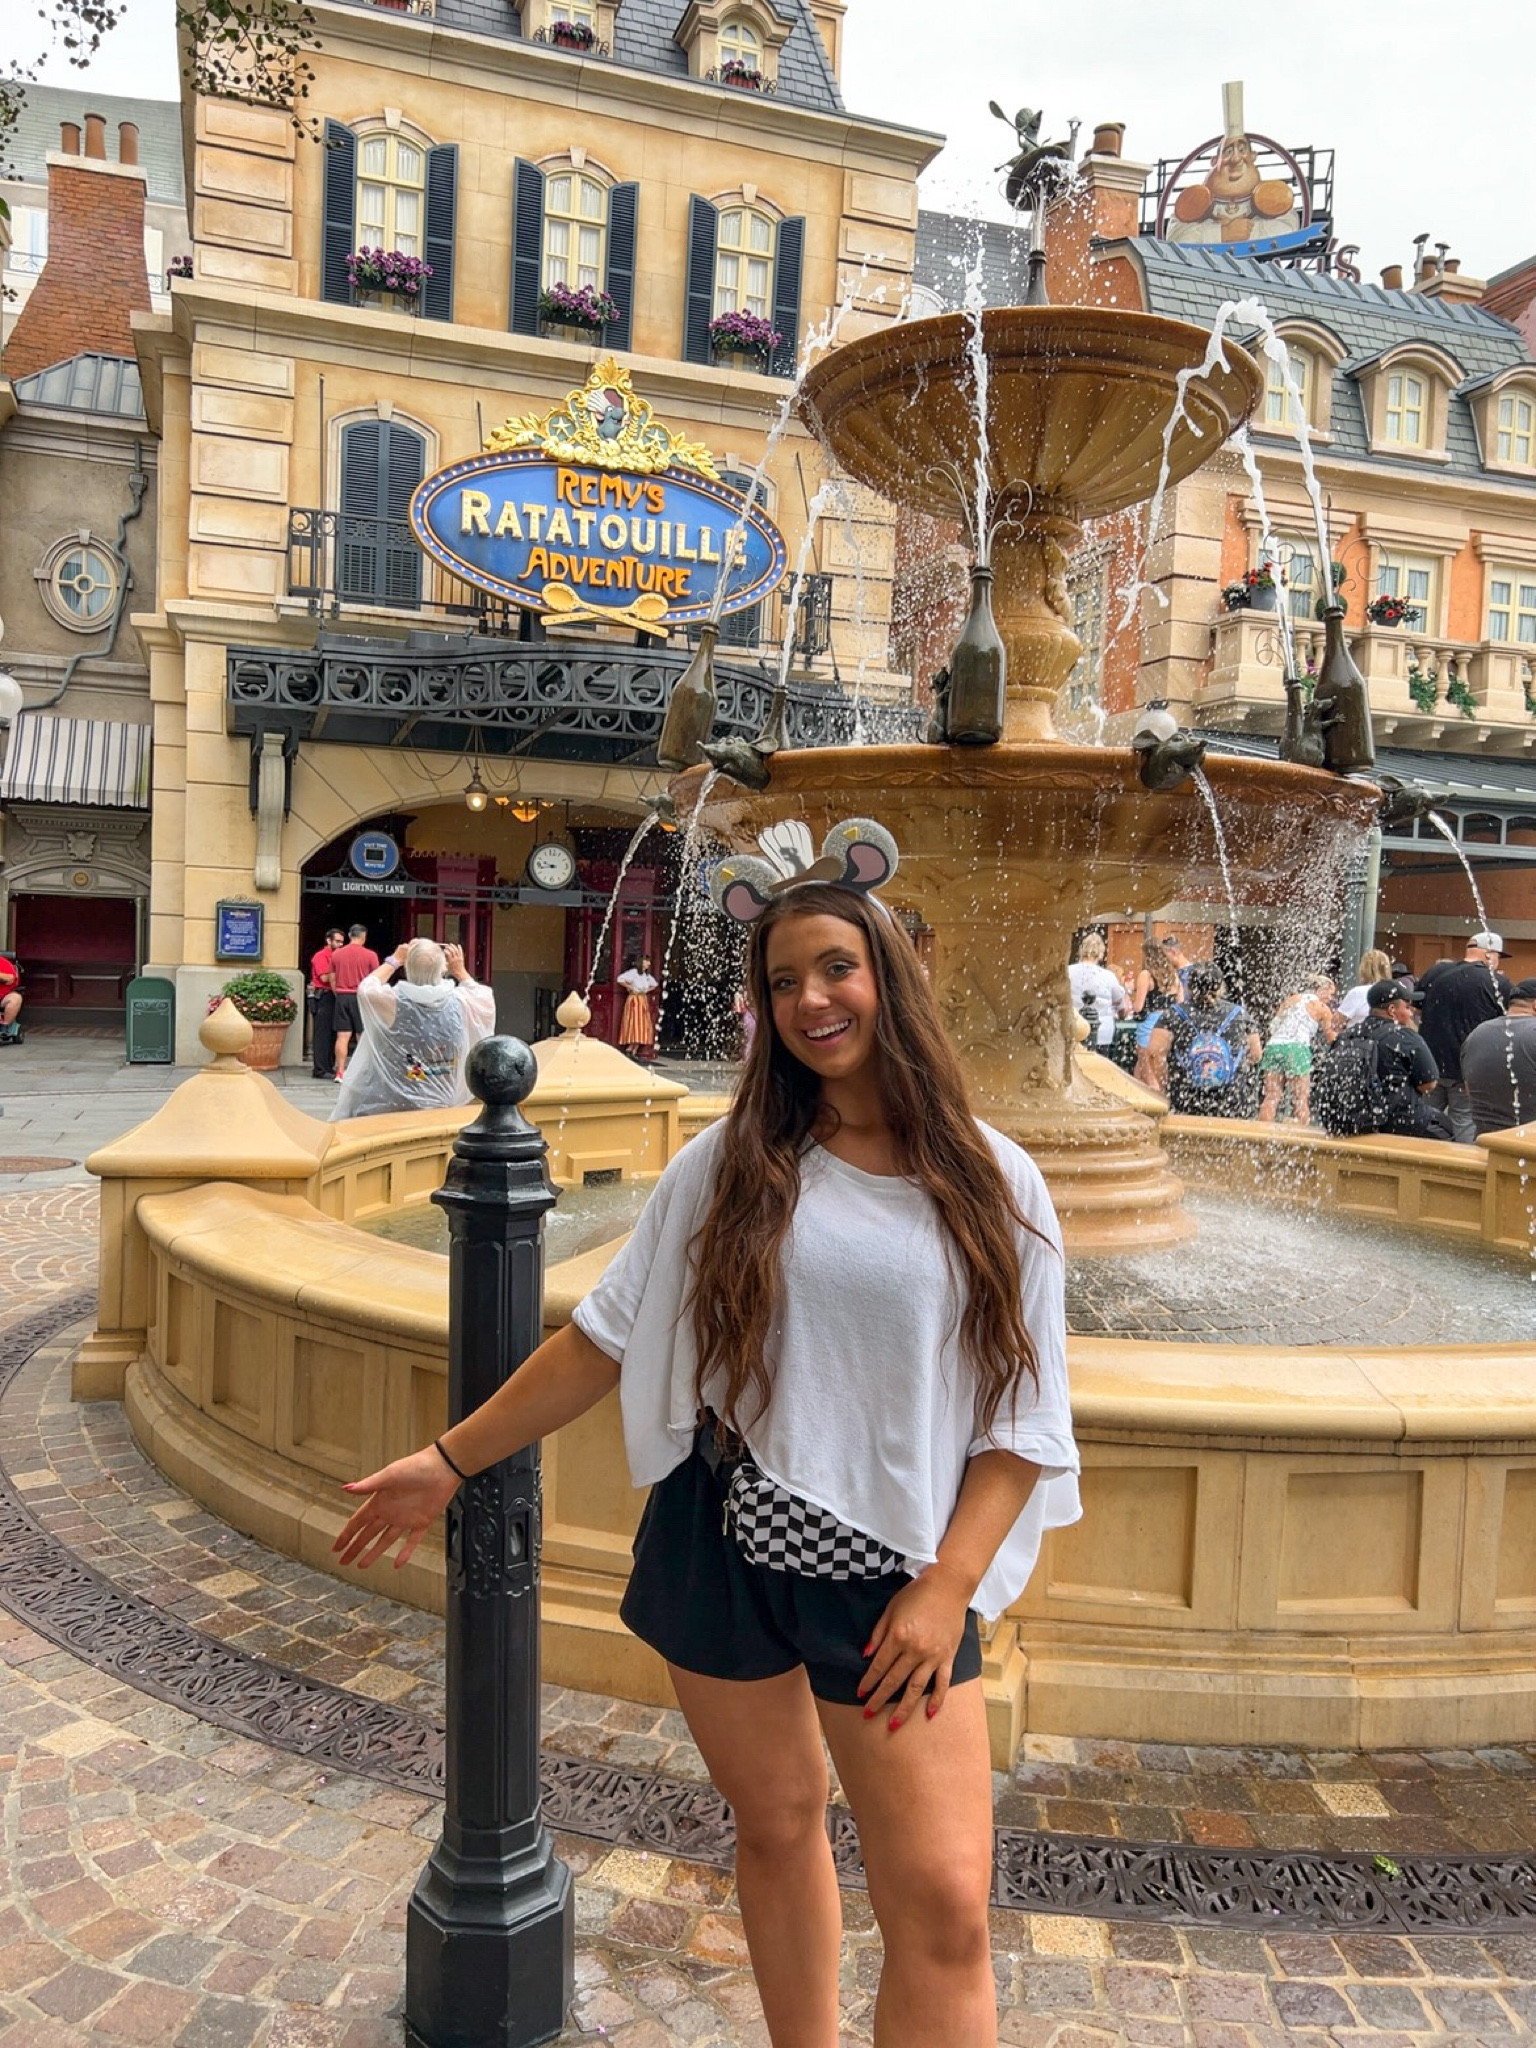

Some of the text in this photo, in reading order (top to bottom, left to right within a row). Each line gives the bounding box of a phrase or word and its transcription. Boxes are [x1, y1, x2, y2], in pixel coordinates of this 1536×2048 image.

[557, 467, 665, 514] REMY'S
[460, 489, 748, 568] RATATOUILLE
[517, 546, 692, 598] ADVENTURE
[342, 881, 405, 895] LIGHTNING LANE
